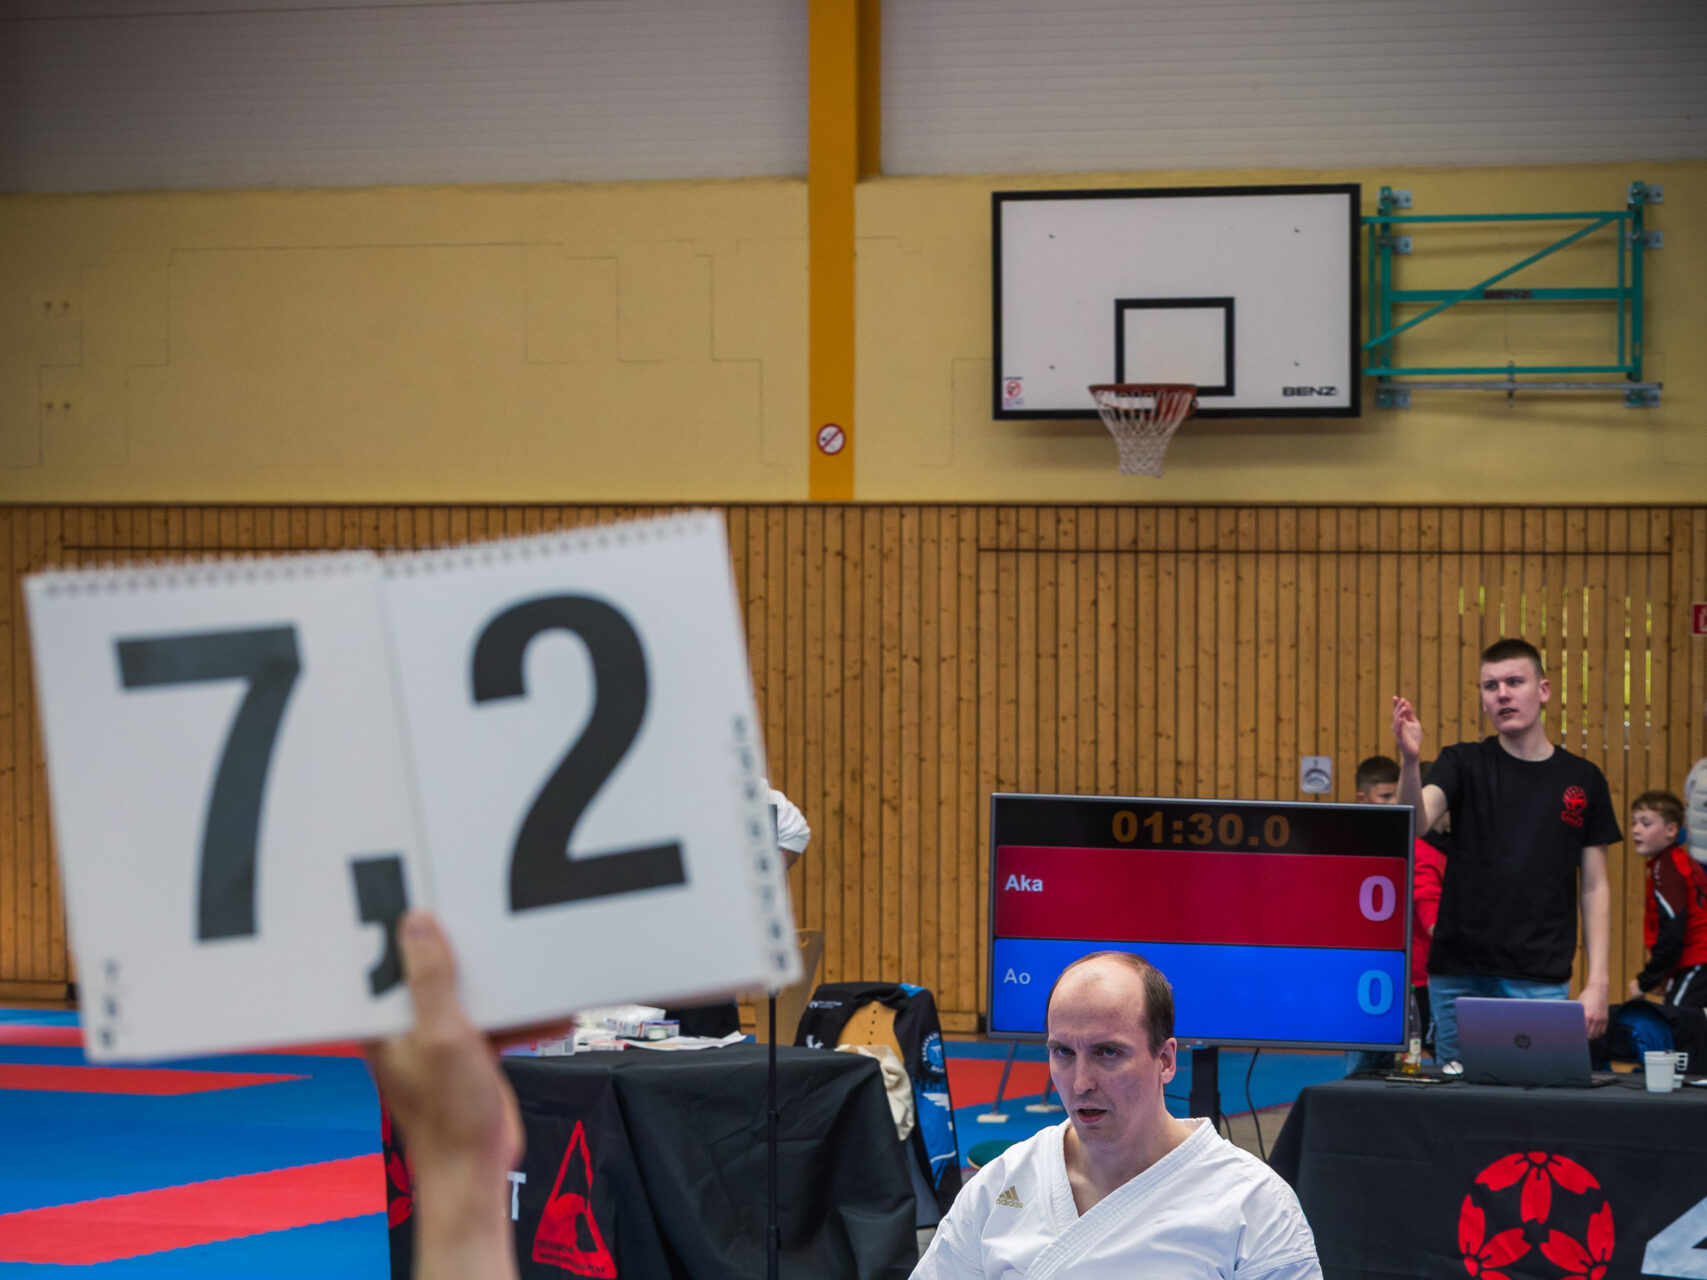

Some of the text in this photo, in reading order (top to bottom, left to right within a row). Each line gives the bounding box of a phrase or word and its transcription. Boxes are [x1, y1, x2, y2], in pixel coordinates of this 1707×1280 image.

[1282, 386, 1336, 397] BENZ
[1112, 810, 1290, 847] 01:30.0
[1004, 874, 1044, 892] Aka
[1358, 875, 1397, 922] 0
[1003, 968, 1031, 985] Ao
[1357, 969, 1393, 1015] 0
